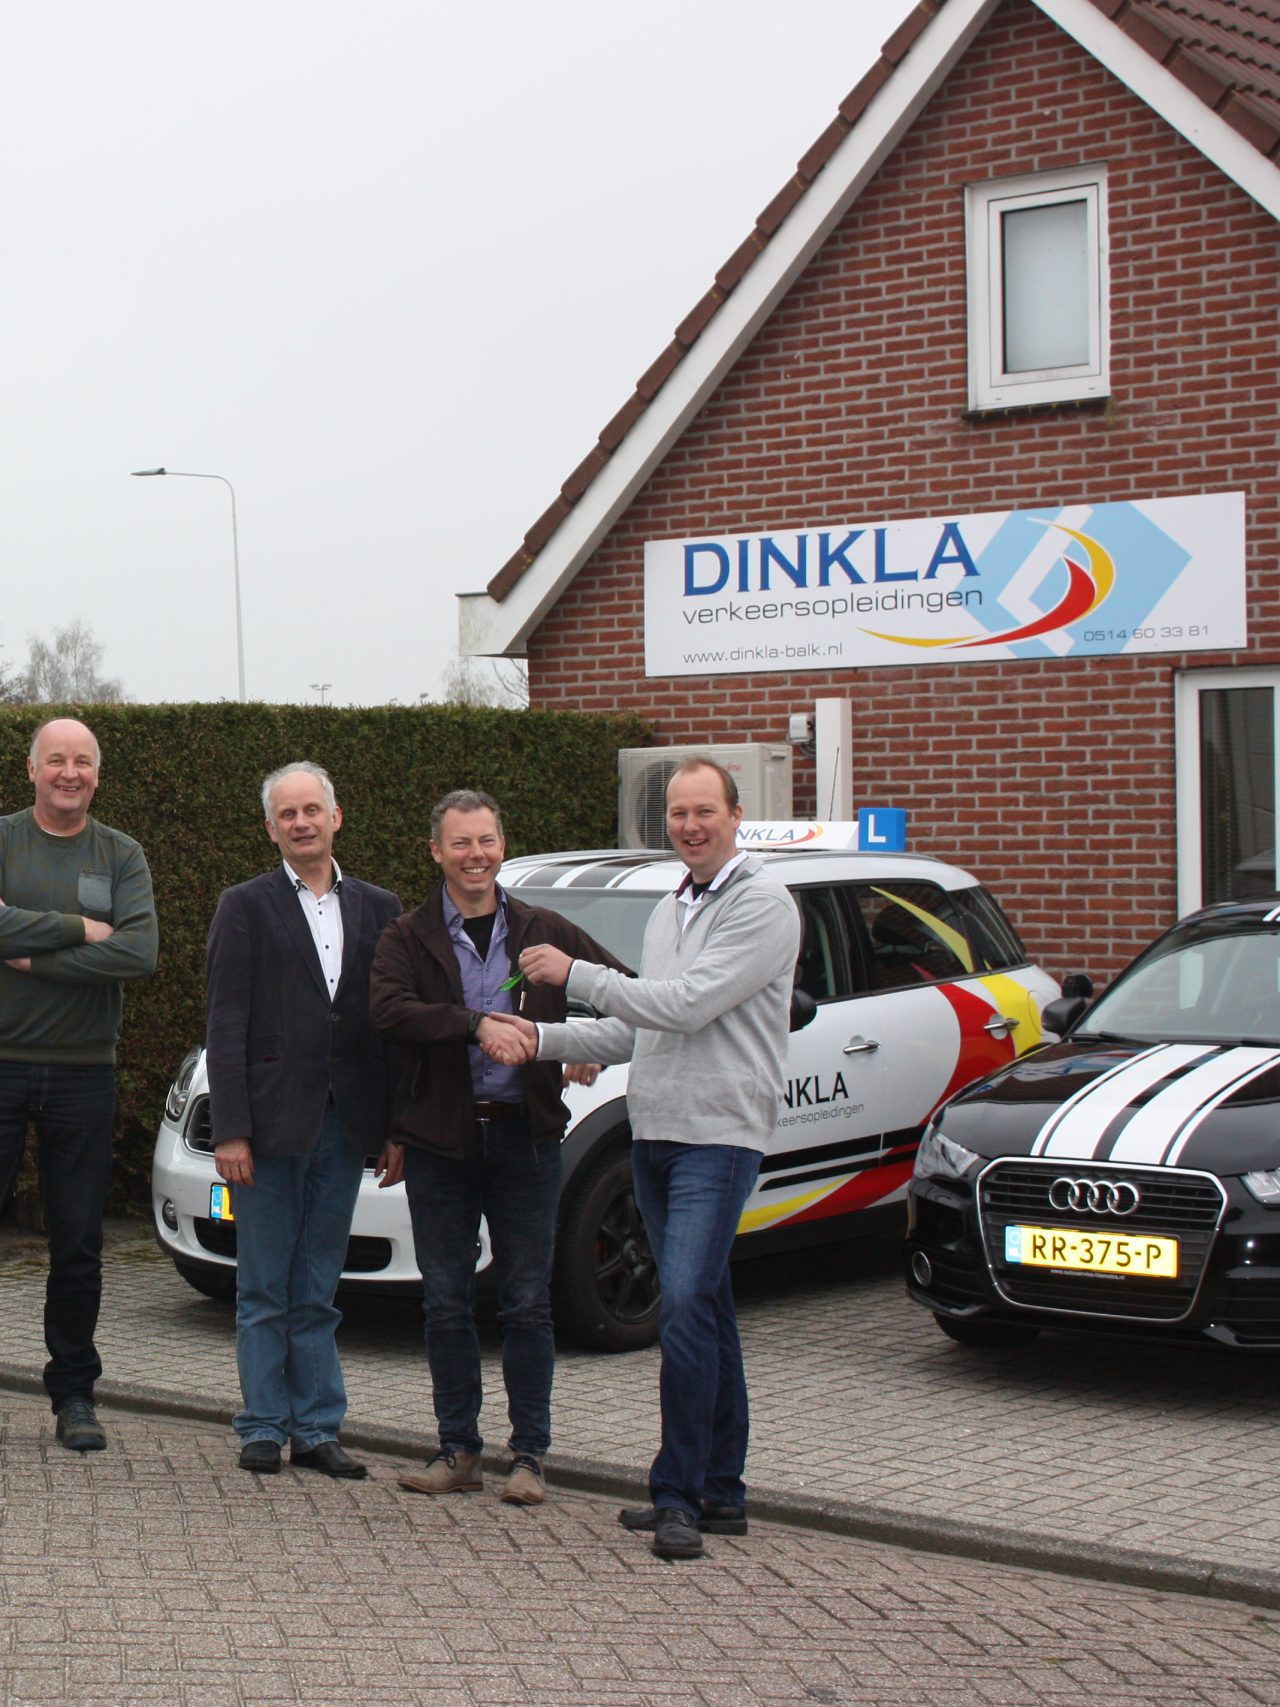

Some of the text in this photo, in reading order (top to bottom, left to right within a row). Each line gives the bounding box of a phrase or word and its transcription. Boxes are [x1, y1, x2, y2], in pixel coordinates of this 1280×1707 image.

[682, 521, 981, 597] DINKLA
[682, 588, 983, 625] verkeersopleidingen
[1083, 625, 1209, 642] 0514 60 33 81
[683, 642, 843, 664] www.dinkla-balk.nl
[736, 829, 794, 841] NKLA
[867, 814, 887, 843] L
[783, 1071, 849, 1109] NKLA
[776, 1103, 865, 1127] keersopleidingen
[1031, 1233, 1162, 1269] RR-375-P
